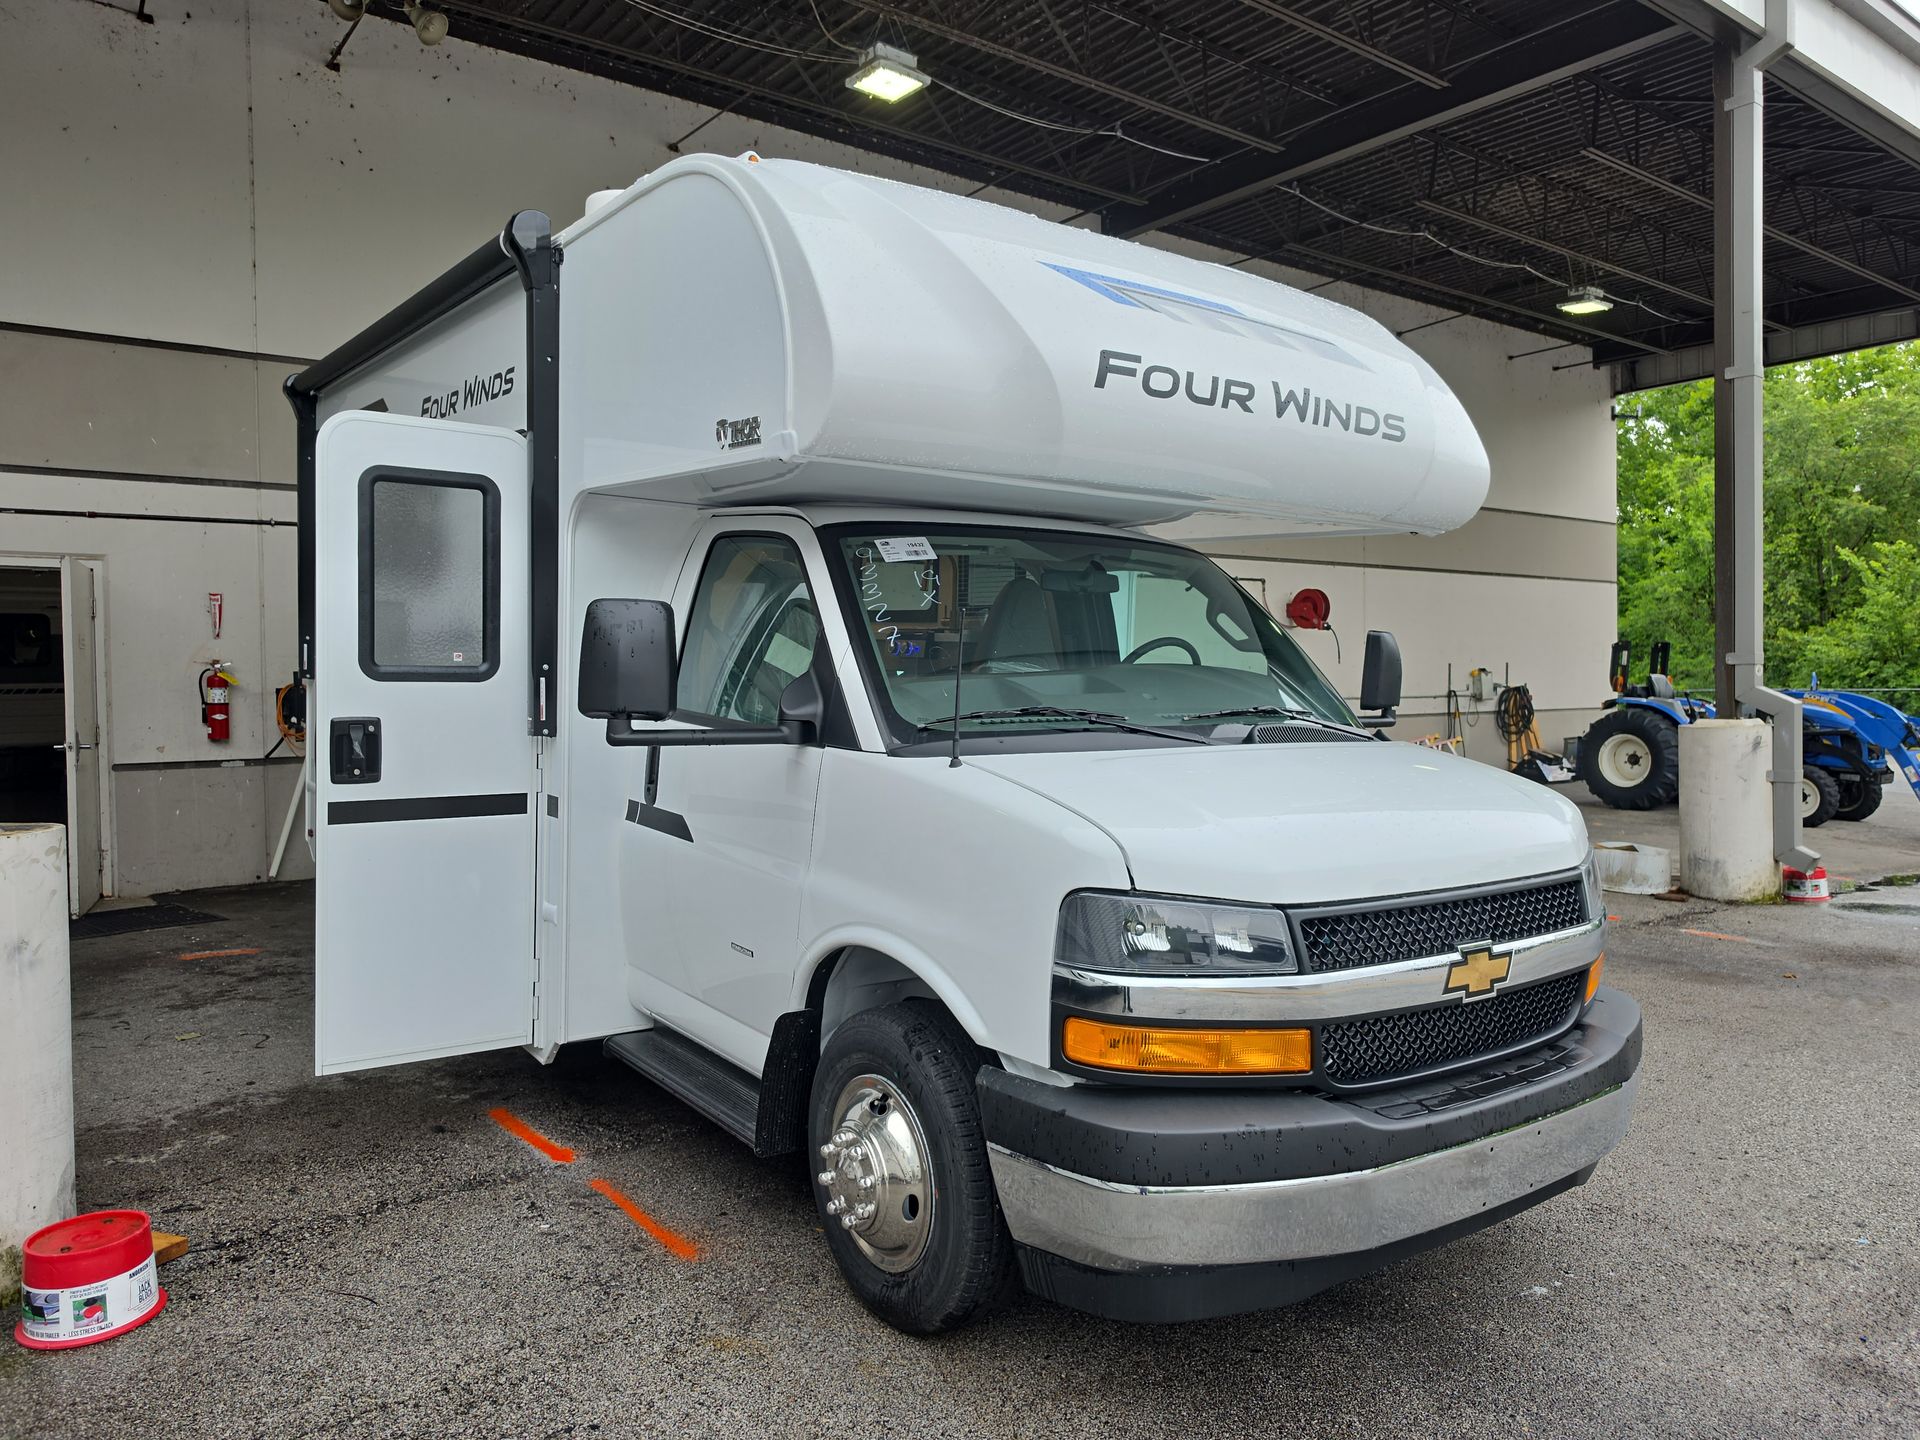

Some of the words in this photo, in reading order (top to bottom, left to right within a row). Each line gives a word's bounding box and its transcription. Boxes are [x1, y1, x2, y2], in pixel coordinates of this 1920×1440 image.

[420, 389, 459, 419] FOUR
[463, 366, 515, 411] WINDS
[1094, 349, 1256, 414] FOUR
[1271, 380, 1407, 443] WINDS
[729, 416, 761, 443] THOR
[138, 1279, 151, 1295] JACK
[138, 1289, 154, 1304] BLOCK
[68, 1328, 80, 1338] LESS
[80, 1325, 96, 1337] STRESS
